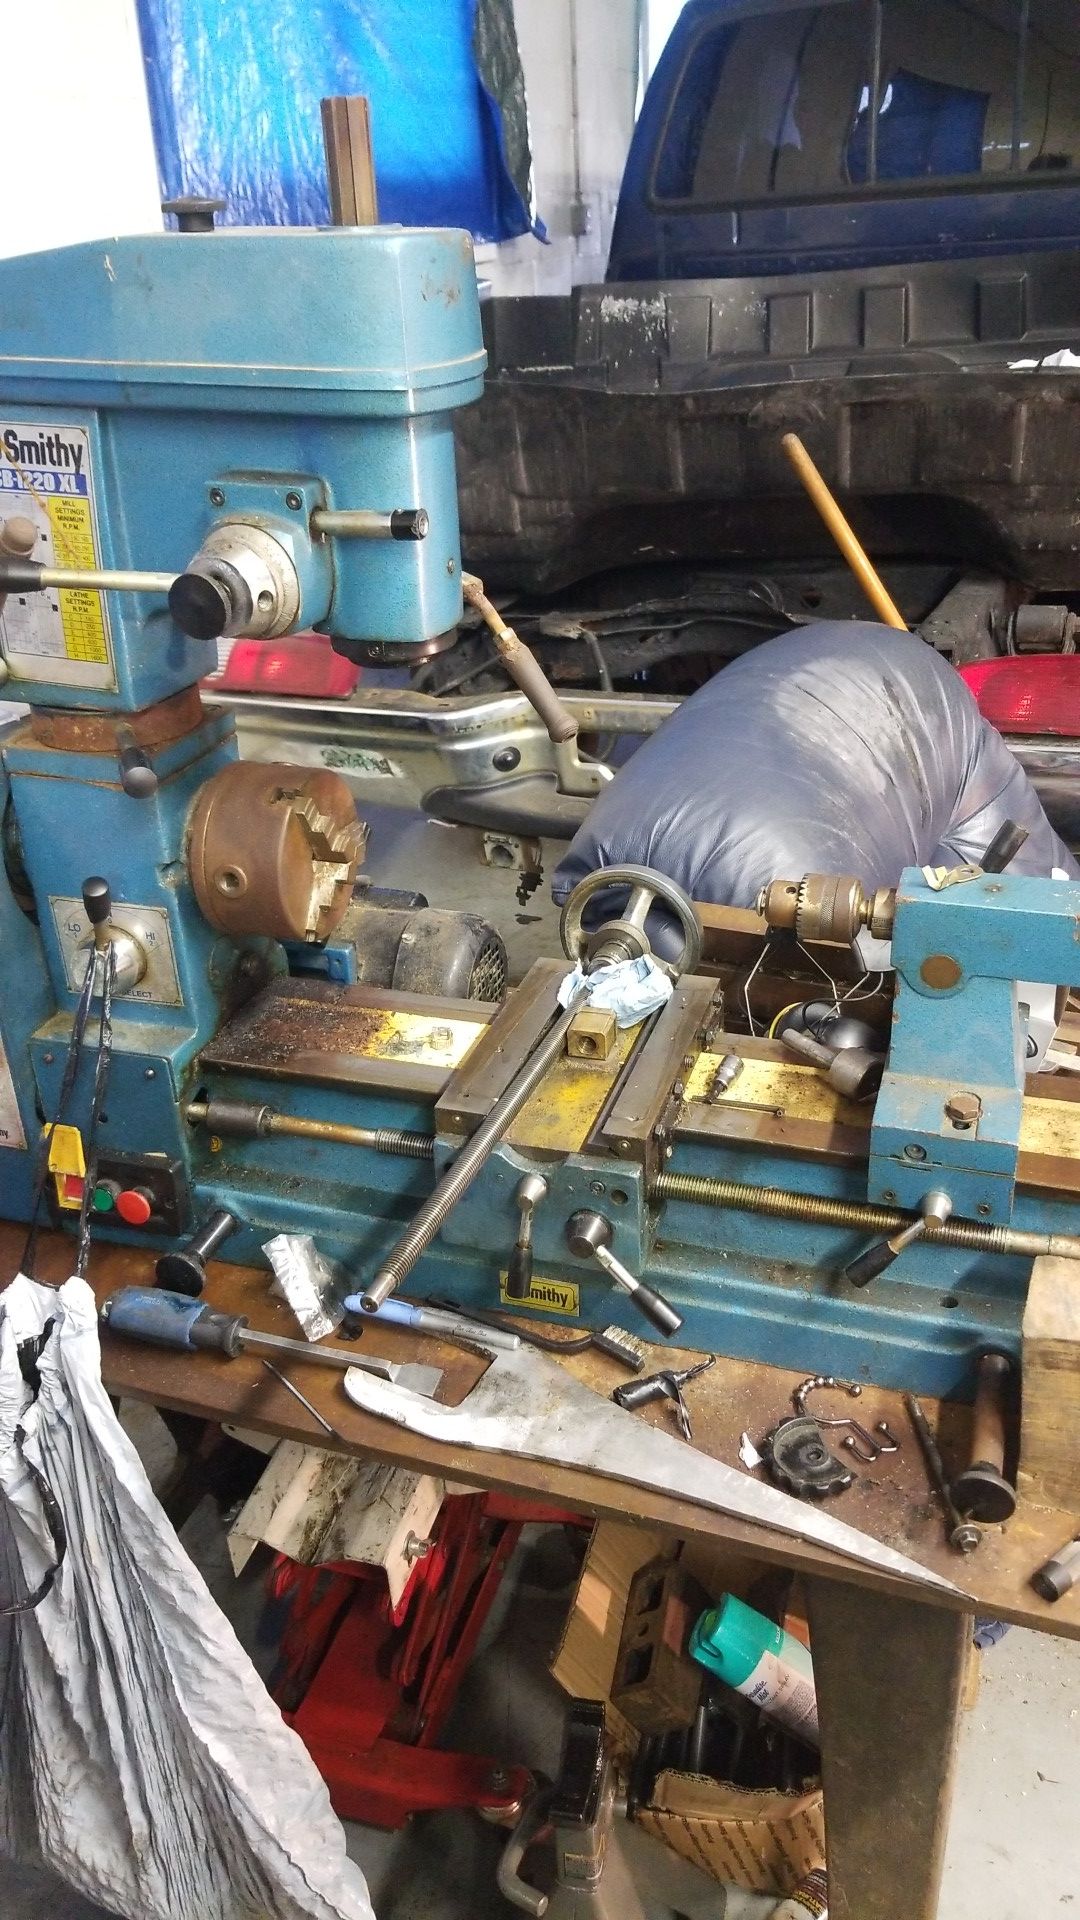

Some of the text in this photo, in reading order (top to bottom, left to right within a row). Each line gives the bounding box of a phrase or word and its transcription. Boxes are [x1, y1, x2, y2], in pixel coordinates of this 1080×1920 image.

[4, 429, 83, 475] Smithy
[0, 469, 80, 493] B-1220 XL
[55, 507, 85, 516] SETTINGS
[57, 515, 84, 523] MINIMUM
[69, 591, 89, 599] LATHE
[65, 598, 95, 607] SETTINGS
[68, 923, 81, 933] LO
[145, 932, 156, 941] HI
[531, 1286, 568, 1308] mithy
